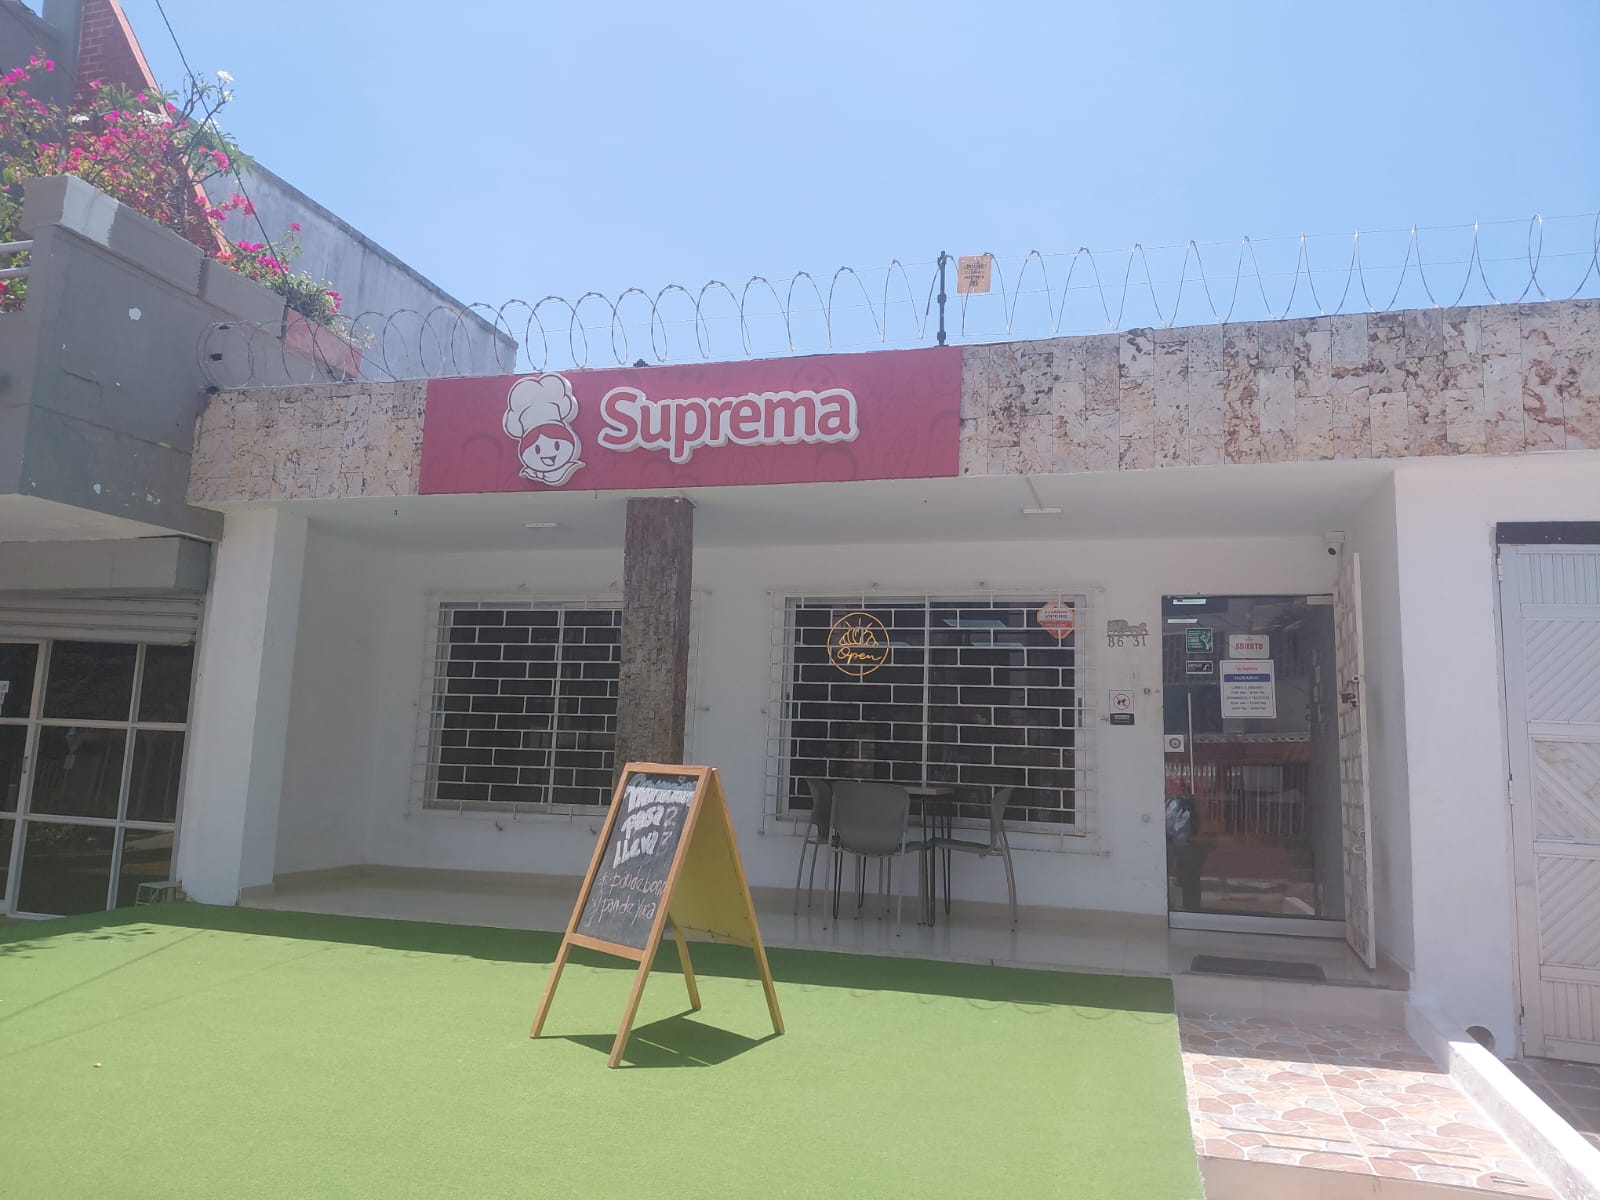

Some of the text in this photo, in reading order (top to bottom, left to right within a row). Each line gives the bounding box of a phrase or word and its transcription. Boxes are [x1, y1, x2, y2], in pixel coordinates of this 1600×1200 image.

[600, 388, 858, 463] Suprema
[837, 646, 882, 665] Open
[664, 806, 678, 829] 2
[656, 831, 672, 856] 3
